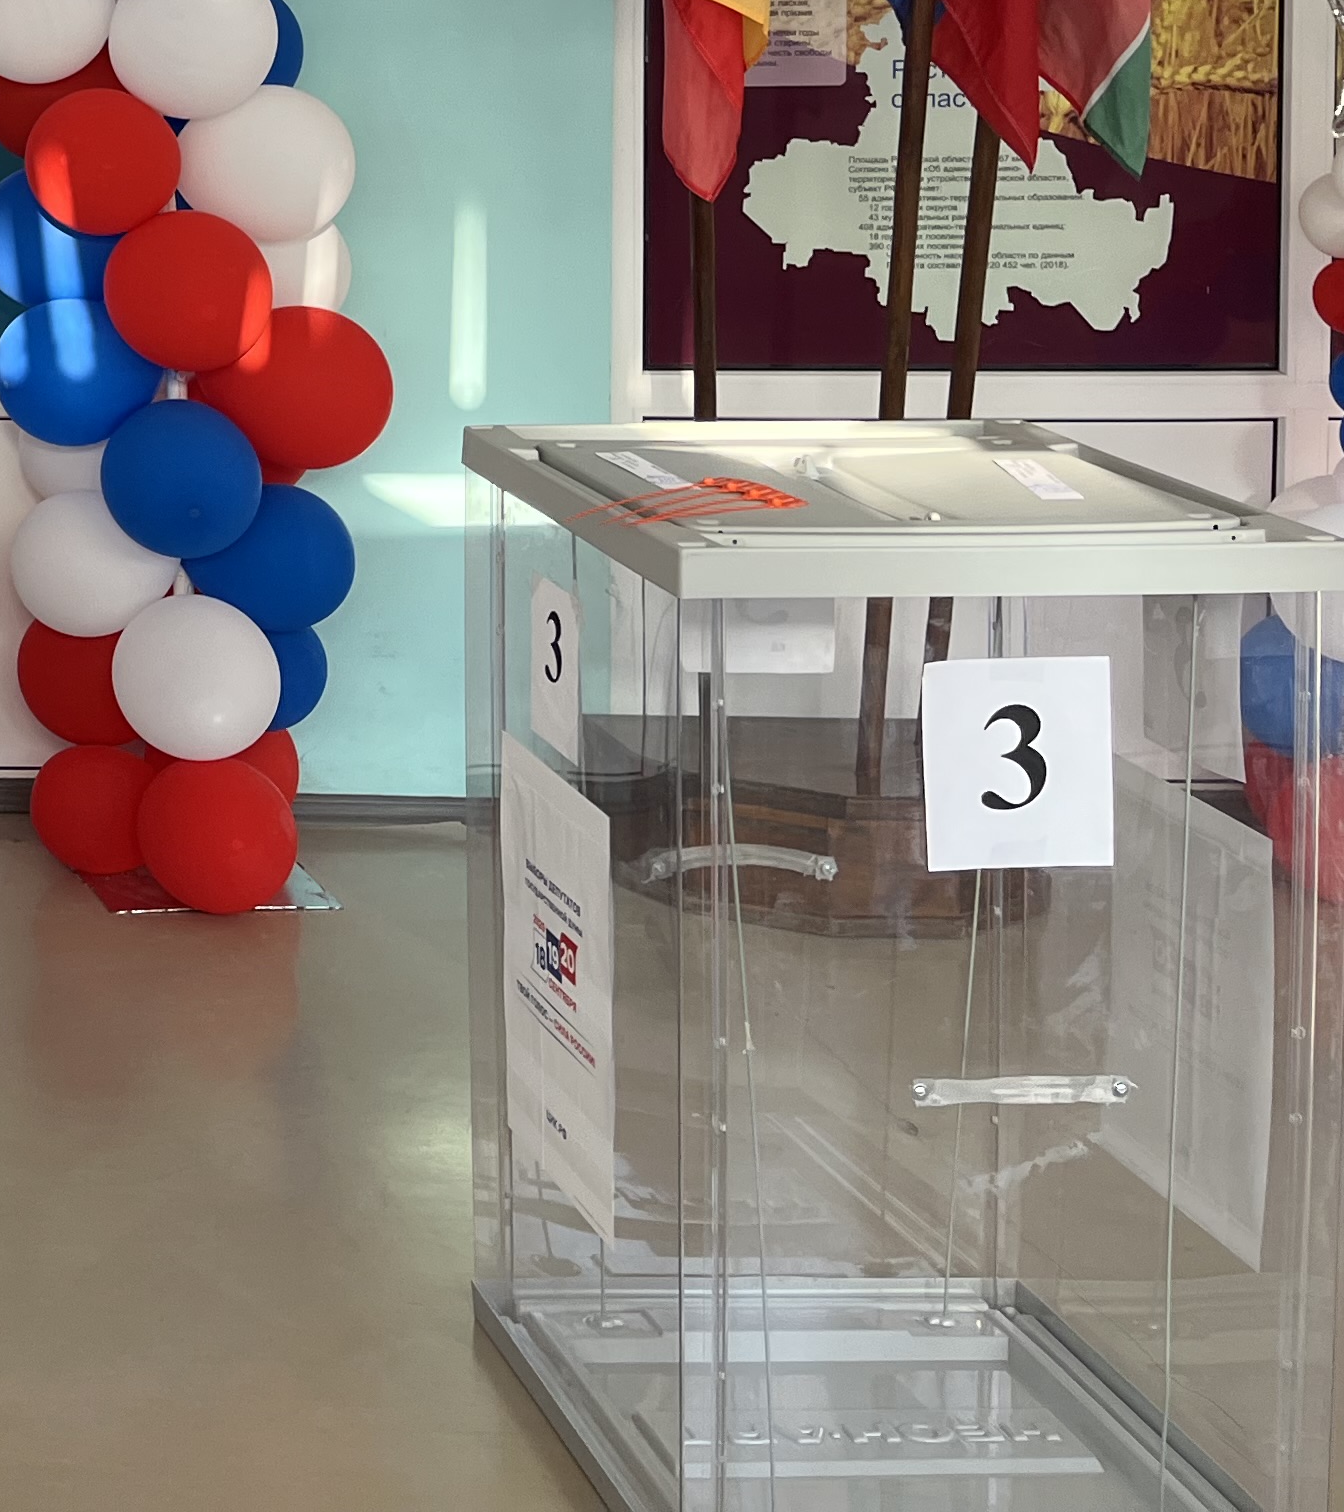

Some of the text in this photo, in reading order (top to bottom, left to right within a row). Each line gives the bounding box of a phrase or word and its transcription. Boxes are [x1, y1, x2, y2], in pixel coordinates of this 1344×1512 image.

[545, 610, 562, 683] 3
[981, 704, 1047, 811] 3
[535, 941, 575, 974] 18 19 20
